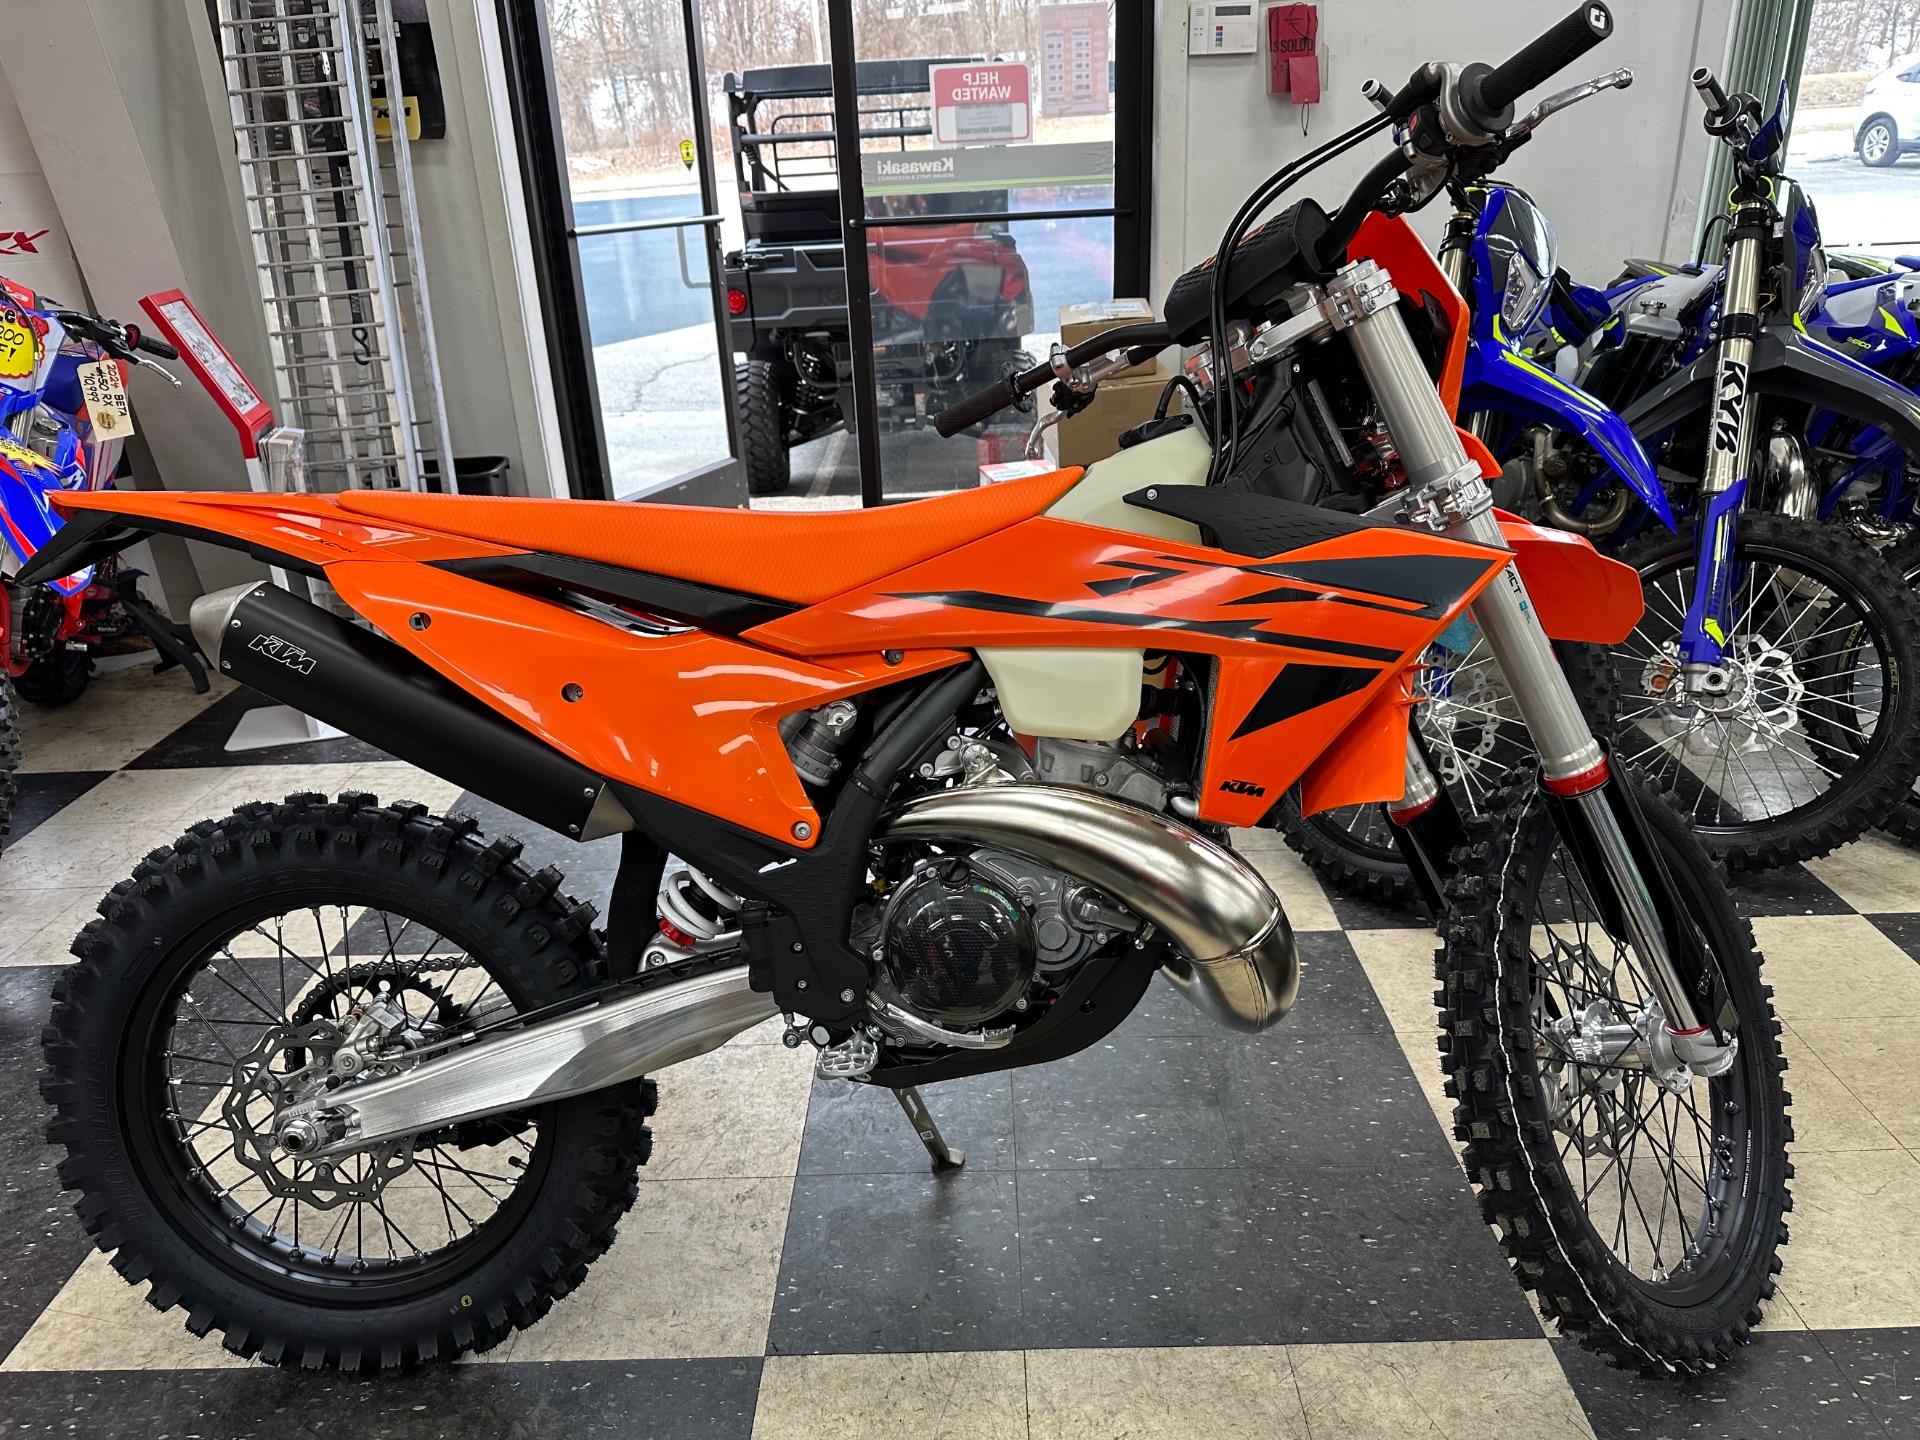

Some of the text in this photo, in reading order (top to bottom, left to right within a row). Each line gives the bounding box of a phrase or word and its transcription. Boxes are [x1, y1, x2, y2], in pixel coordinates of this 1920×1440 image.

[103, 394, 114, 408] RX
[106, 364, 128, 417] 2024 BETA
[1714, 357, 1748, 457] KYB
[248, 634, 317, 675] KTM
[1887, 656, 1899, 688] EXCEL
[1218, 779, 1266, 798] KTM
[87, 1044, 151, 1222] DUNLOP
